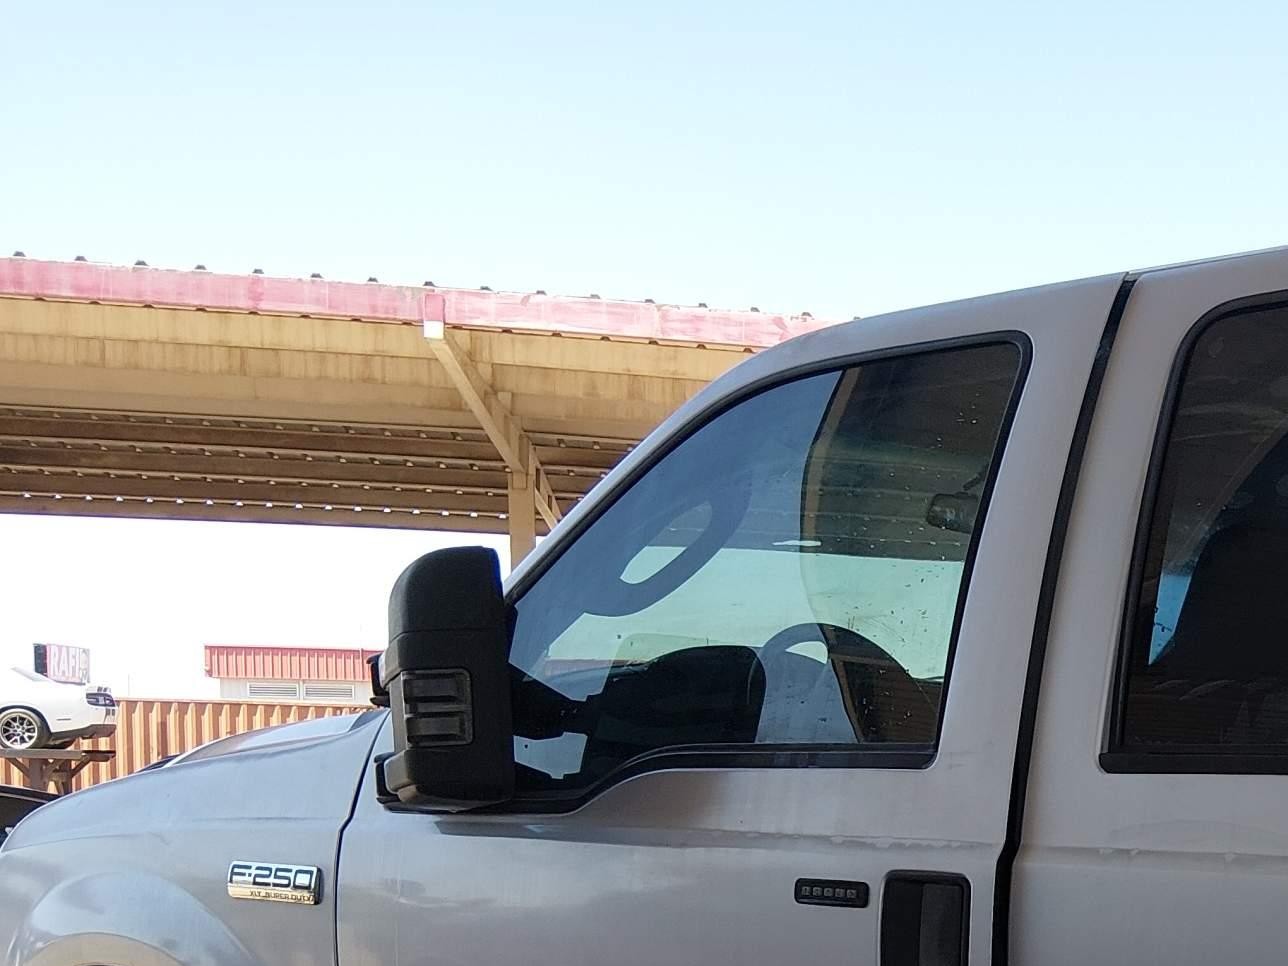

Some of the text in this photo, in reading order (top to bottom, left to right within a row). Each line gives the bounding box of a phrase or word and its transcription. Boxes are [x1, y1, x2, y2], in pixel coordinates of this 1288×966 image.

[50, 645, 80, 679] RAFI
[263, 891, 290, 900] SUPER
[291, 893, 314, 902] DUTY
